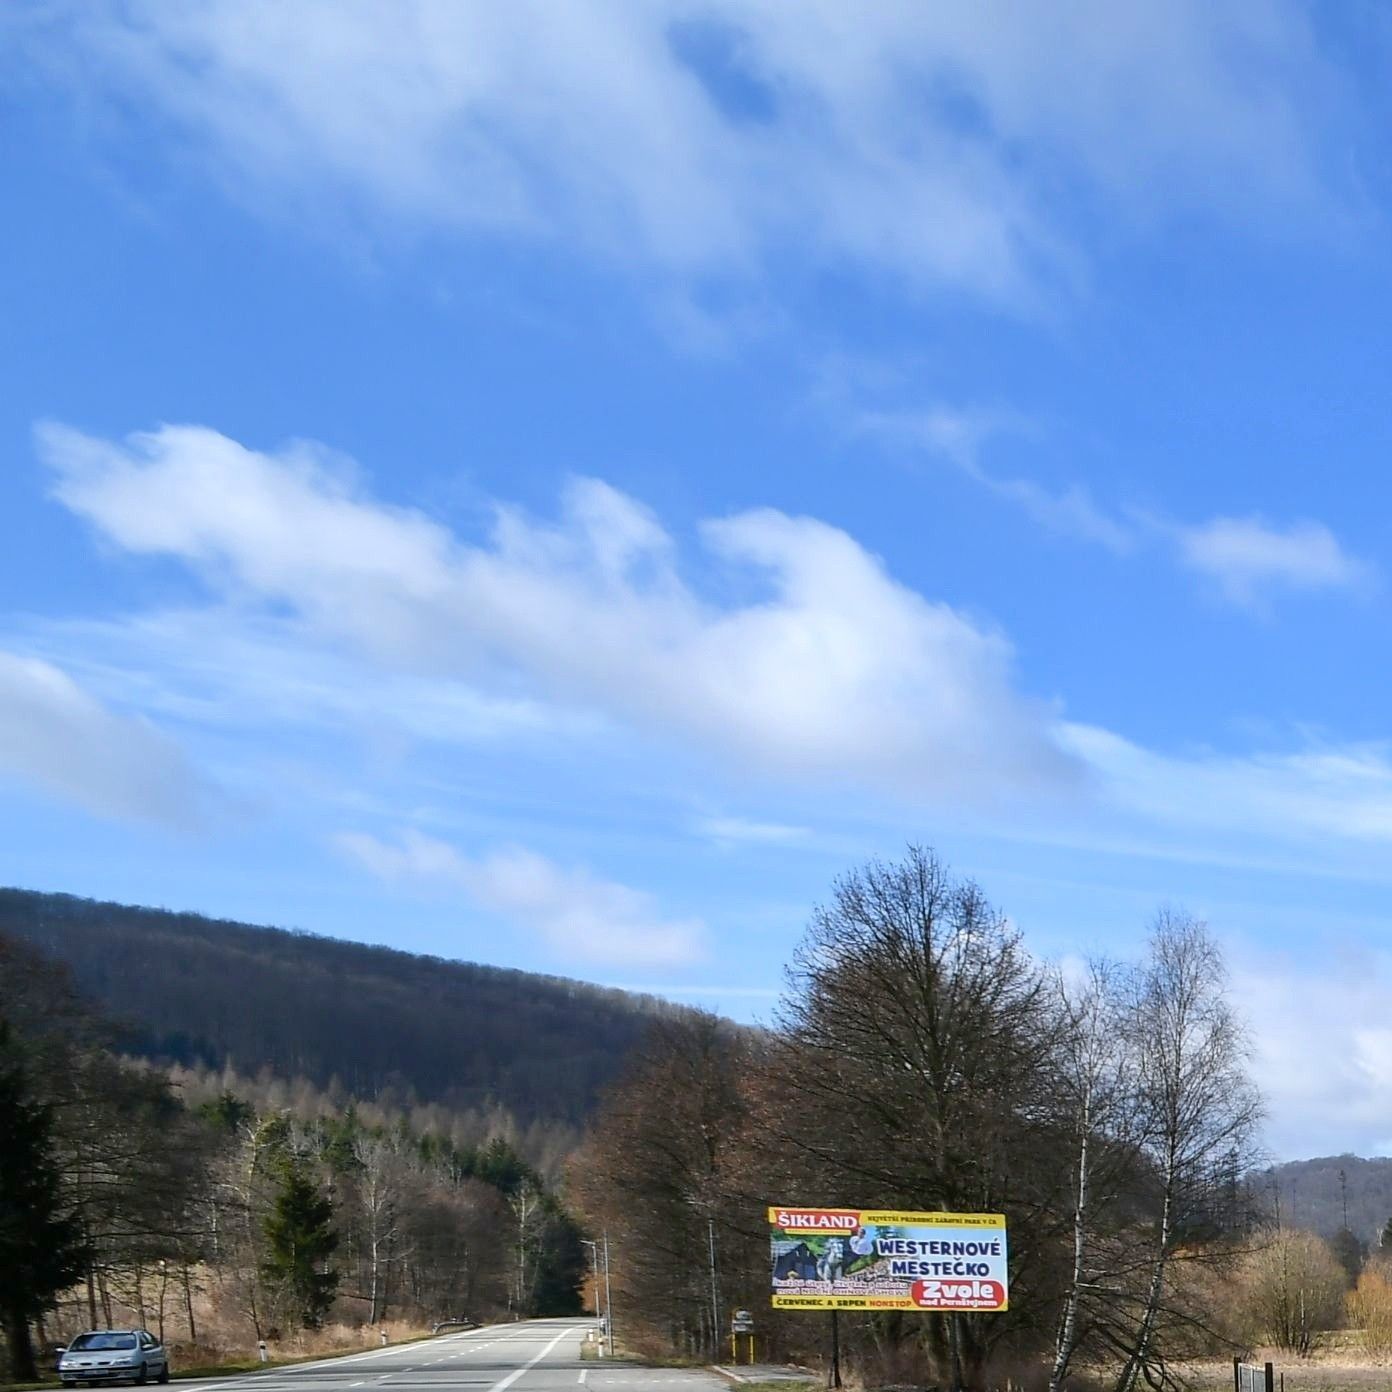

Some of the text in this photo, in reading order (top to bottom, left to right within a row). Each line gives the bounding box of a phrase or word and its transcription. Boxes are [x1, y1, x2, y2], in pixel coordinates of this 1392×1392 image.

[778, 1211, 857, 1228] ŠIKLAND
[880, 1238, 1001, 1256] WESTERNOVÉ
[892, 1257, 990, 1277] MESTEČKO
[922, 1281, 994, 1299] Zvole
[776, 1297, 823, 1306] ČERVENEC
